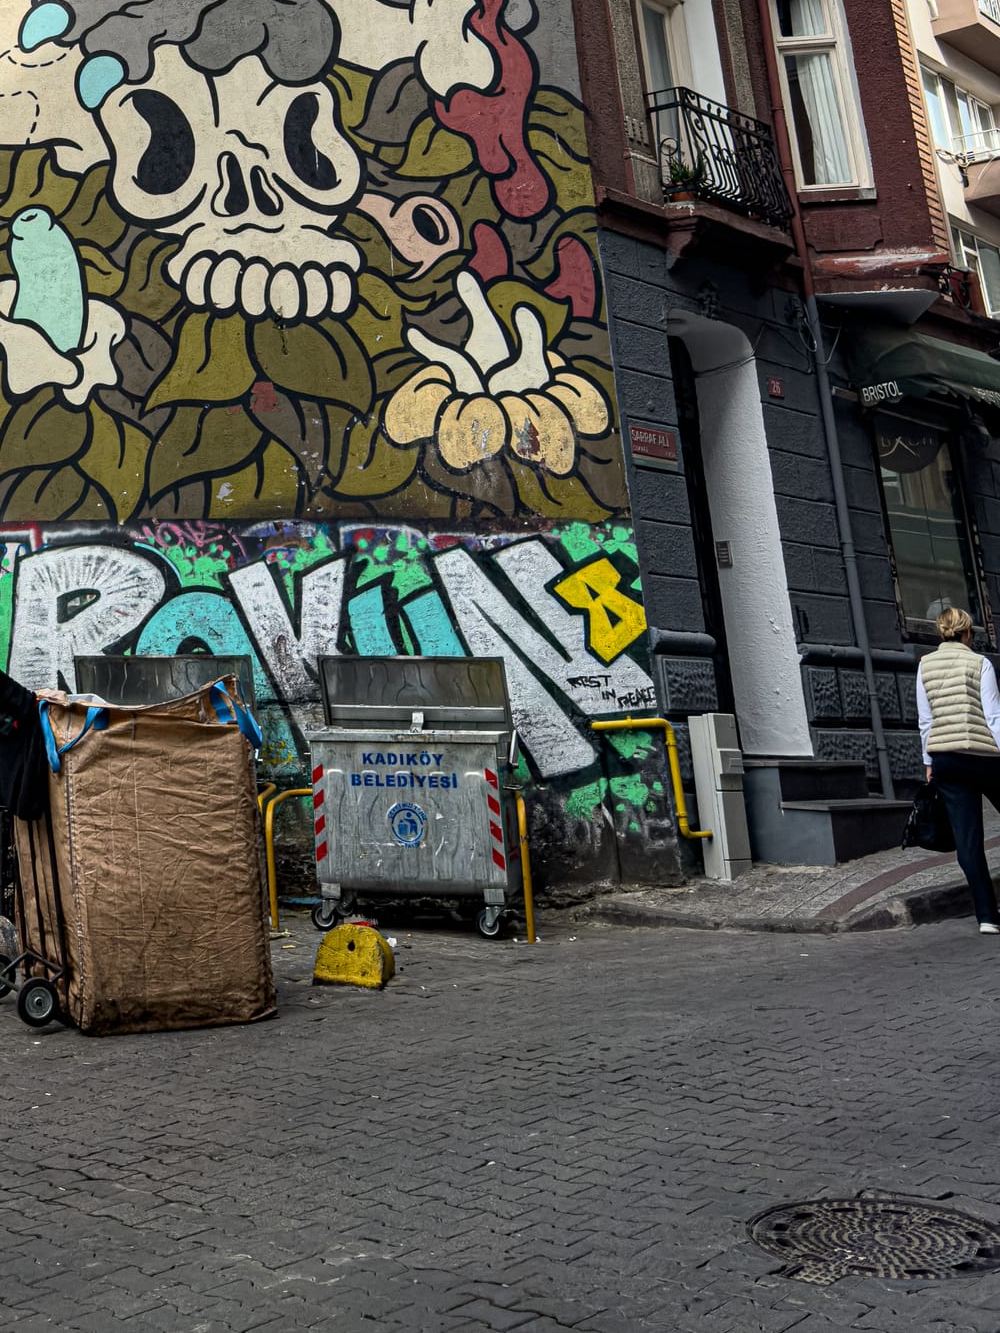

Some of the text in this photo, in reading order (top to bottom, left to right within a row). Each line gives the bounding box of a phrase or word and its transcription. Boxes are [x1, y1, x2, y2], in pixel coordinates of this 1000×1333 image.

[771, 381, 781, 394] 26
[862, 380, 903, 402] BRISTOL
[602, 688, 616, 700] IN
[362, 750, 444, 766] KADIKÖY
[351, 772, 458, 788] BELEDİYESİ
